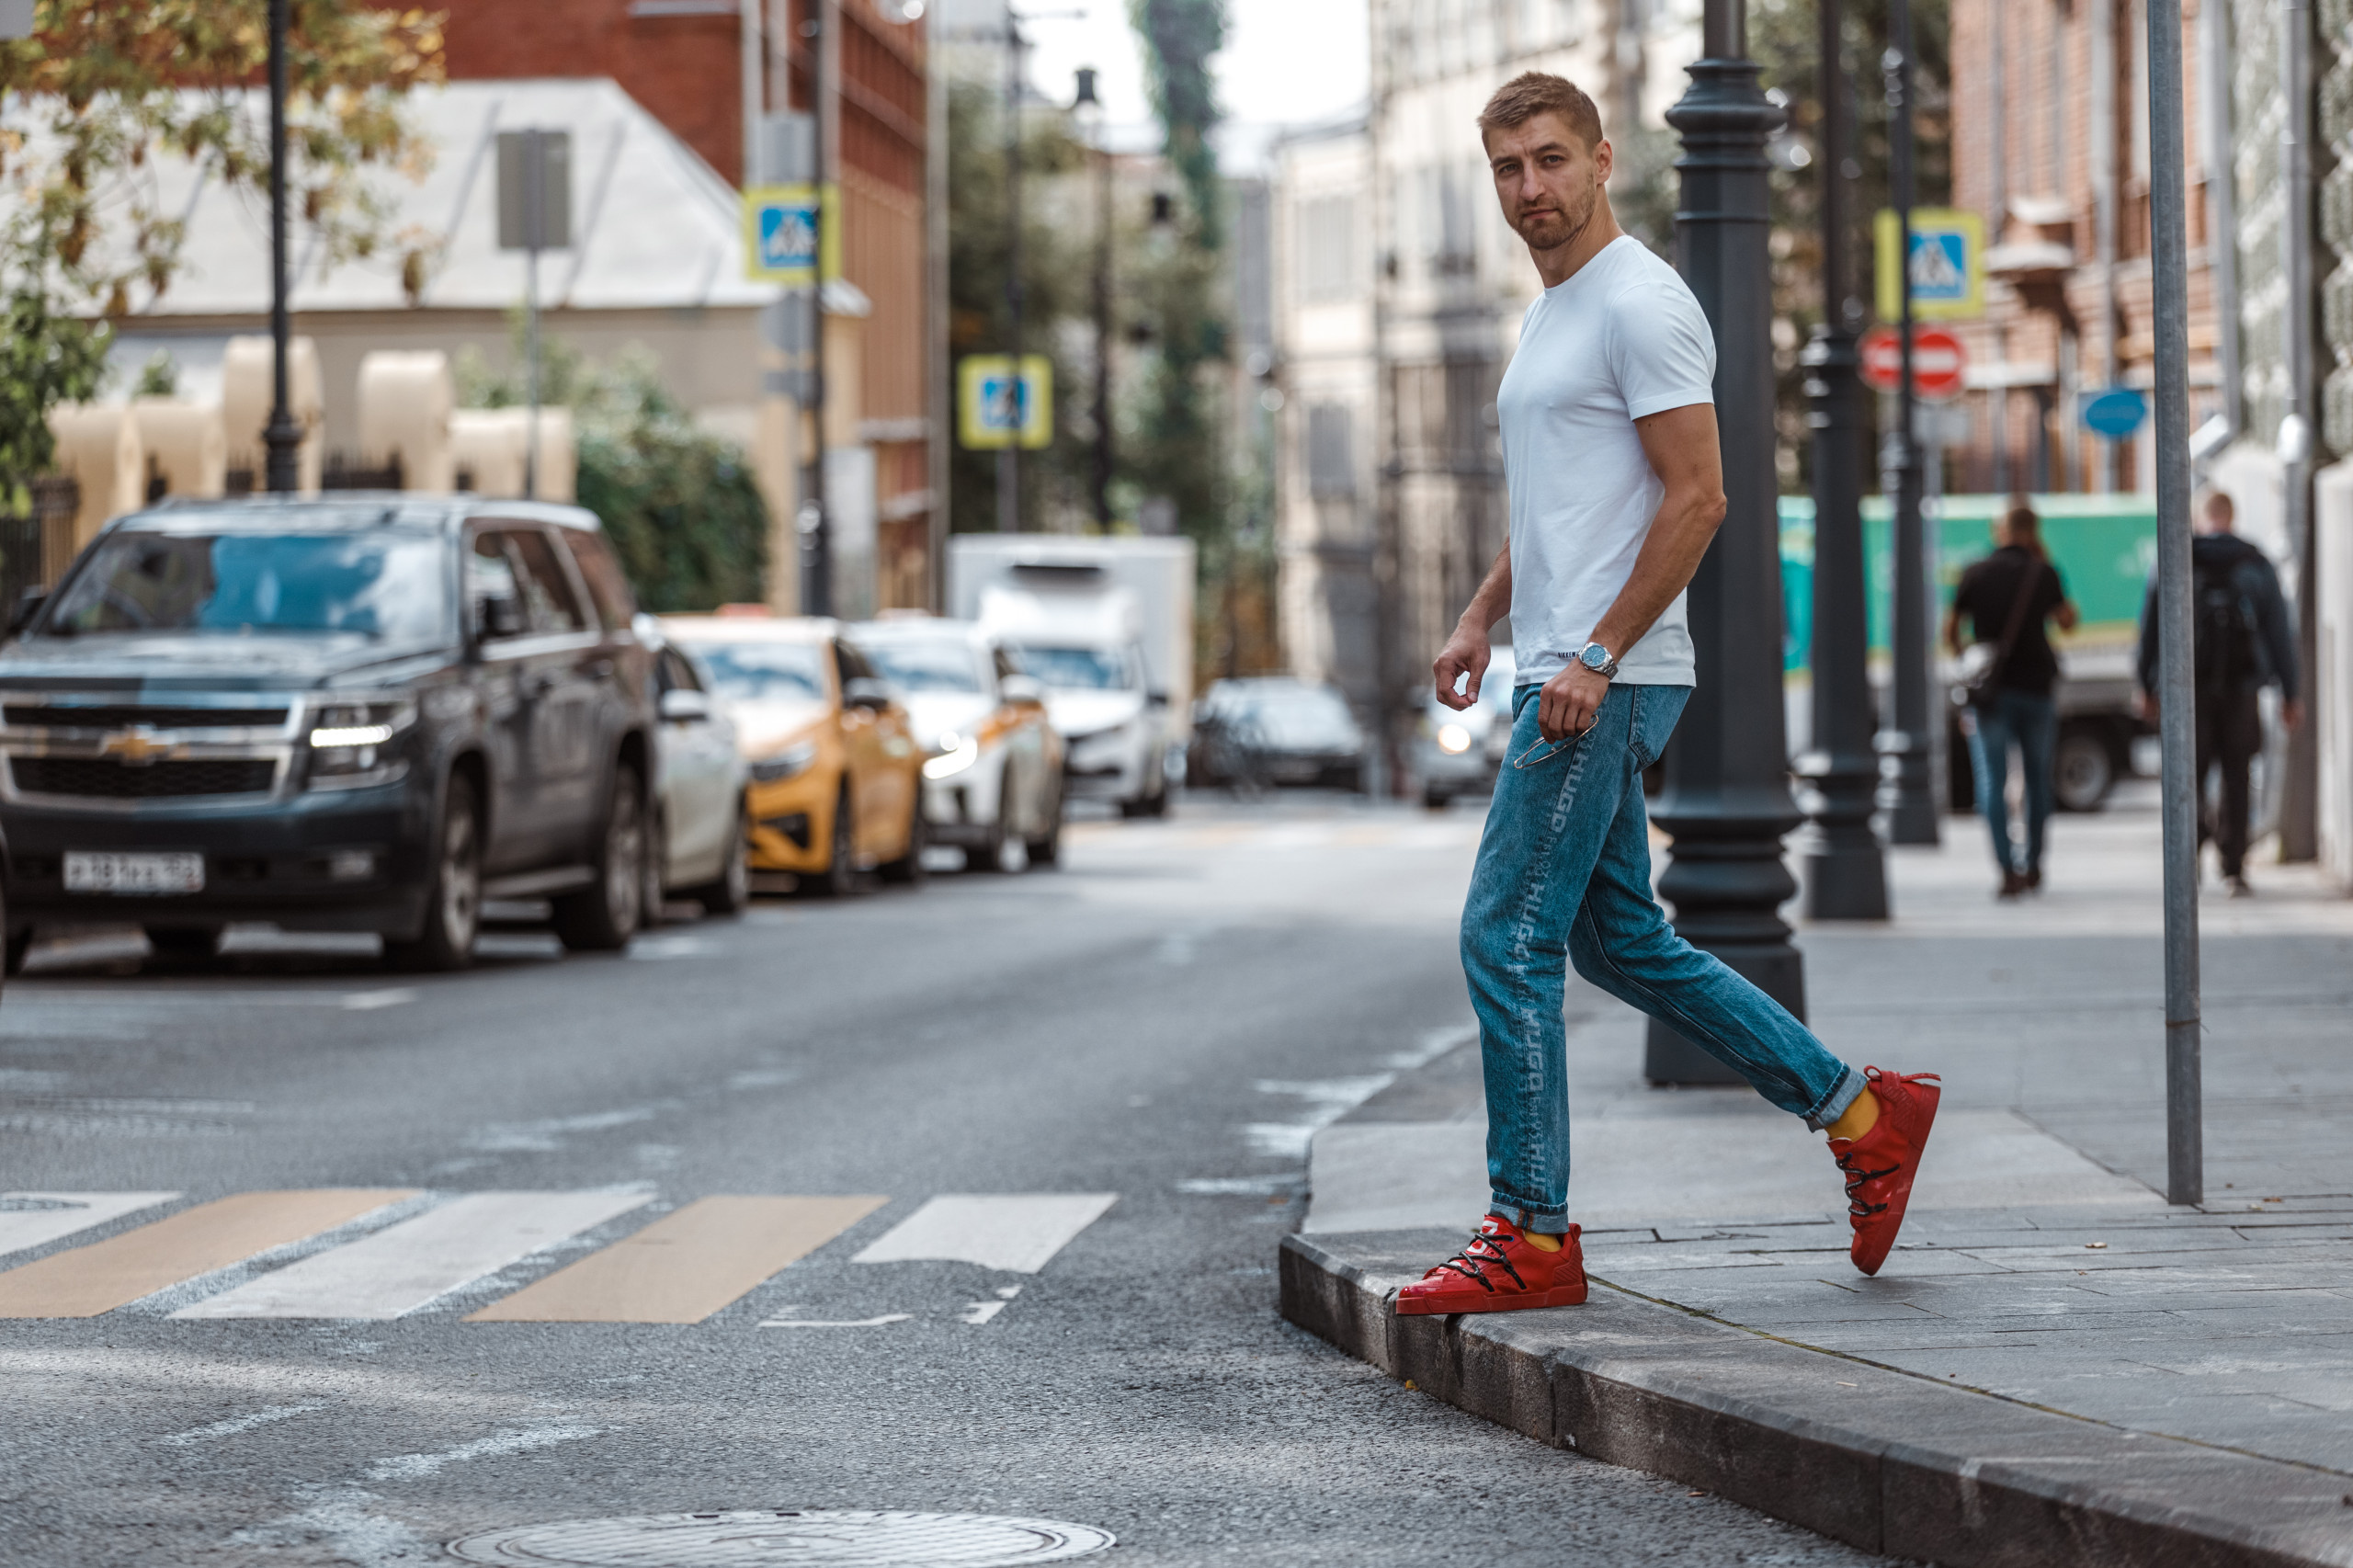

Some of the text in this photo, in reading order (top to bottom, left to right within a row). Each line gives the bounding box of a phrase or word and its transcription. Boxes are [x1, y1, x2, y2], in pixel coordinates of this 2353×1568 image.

[1551, 753, 1588, 833] HUGO
[1513, 882, 1545, 961] HUGO
[1520, 1007, 1544, 1091] HUGO
